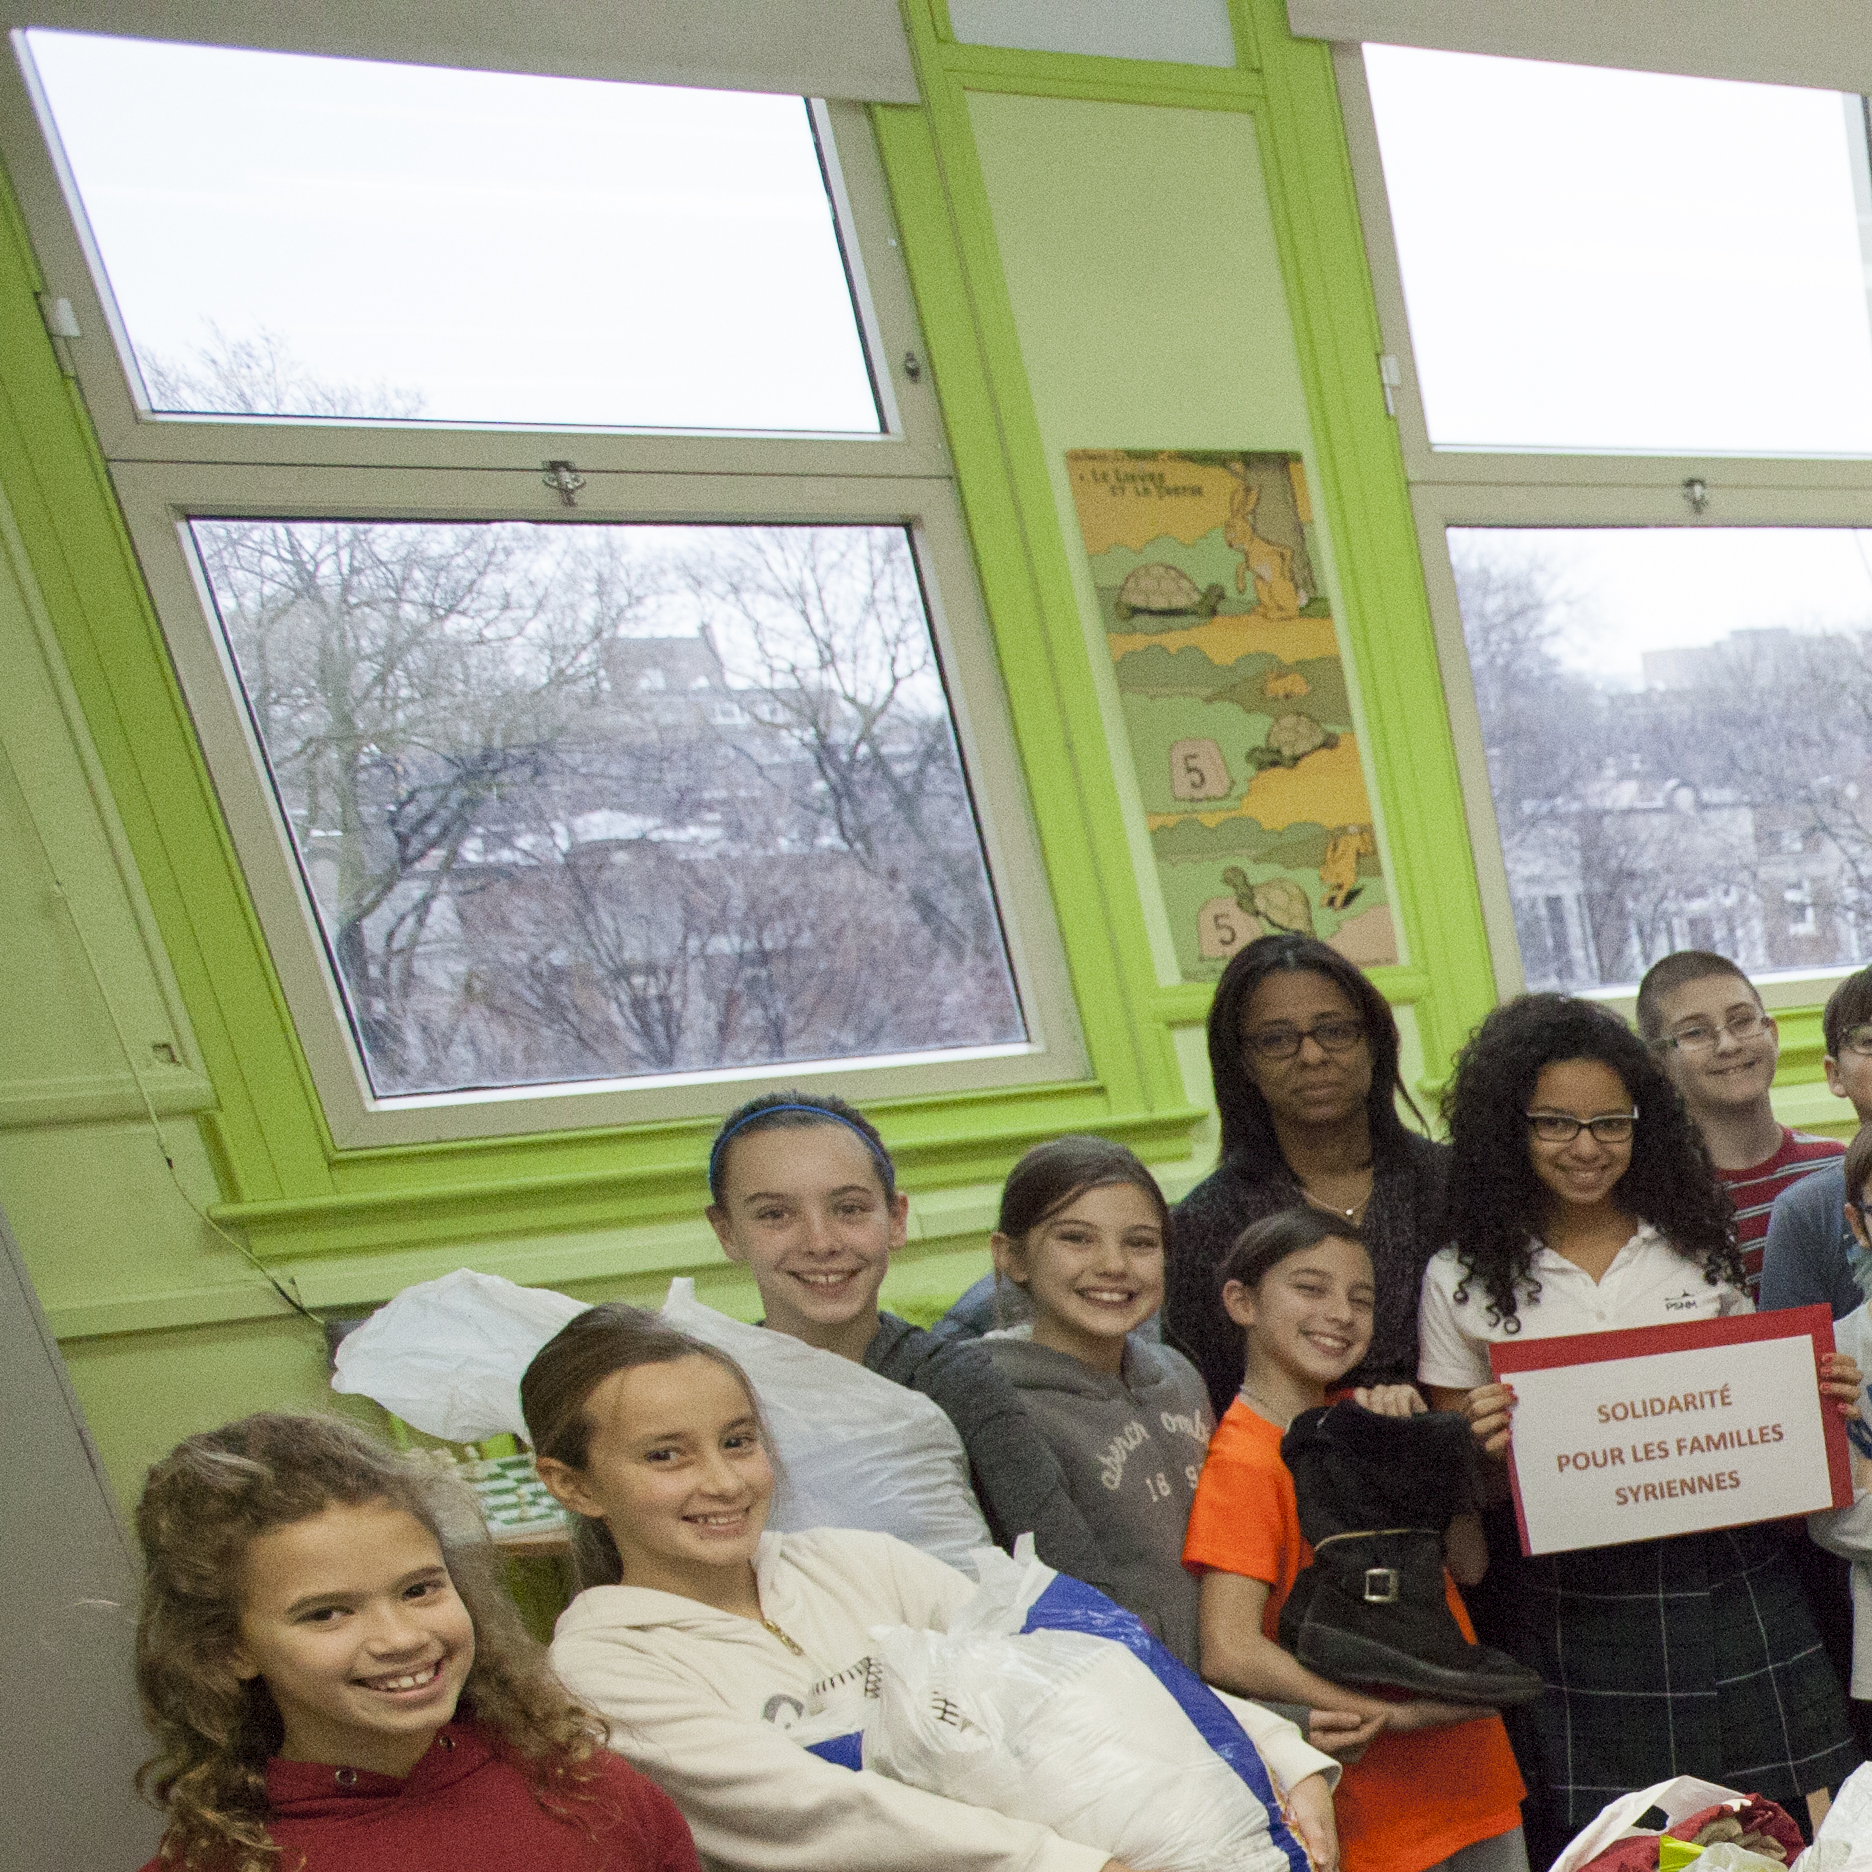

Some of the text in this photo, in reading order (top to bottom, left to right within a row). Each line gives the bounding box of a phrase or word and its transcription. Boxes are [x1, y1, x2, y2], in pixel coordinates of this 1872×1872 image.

[1182, 755, 1206, 790] 5
[1211, 912, 1238, 946] 5
[1597, 1383, 1732, 1424] SOLIDARITÉ
[1556, 1423, 1785, 1473] POUR LES FAMILLES
[1615, 1470, 1742, 1507] SYRIENNES
